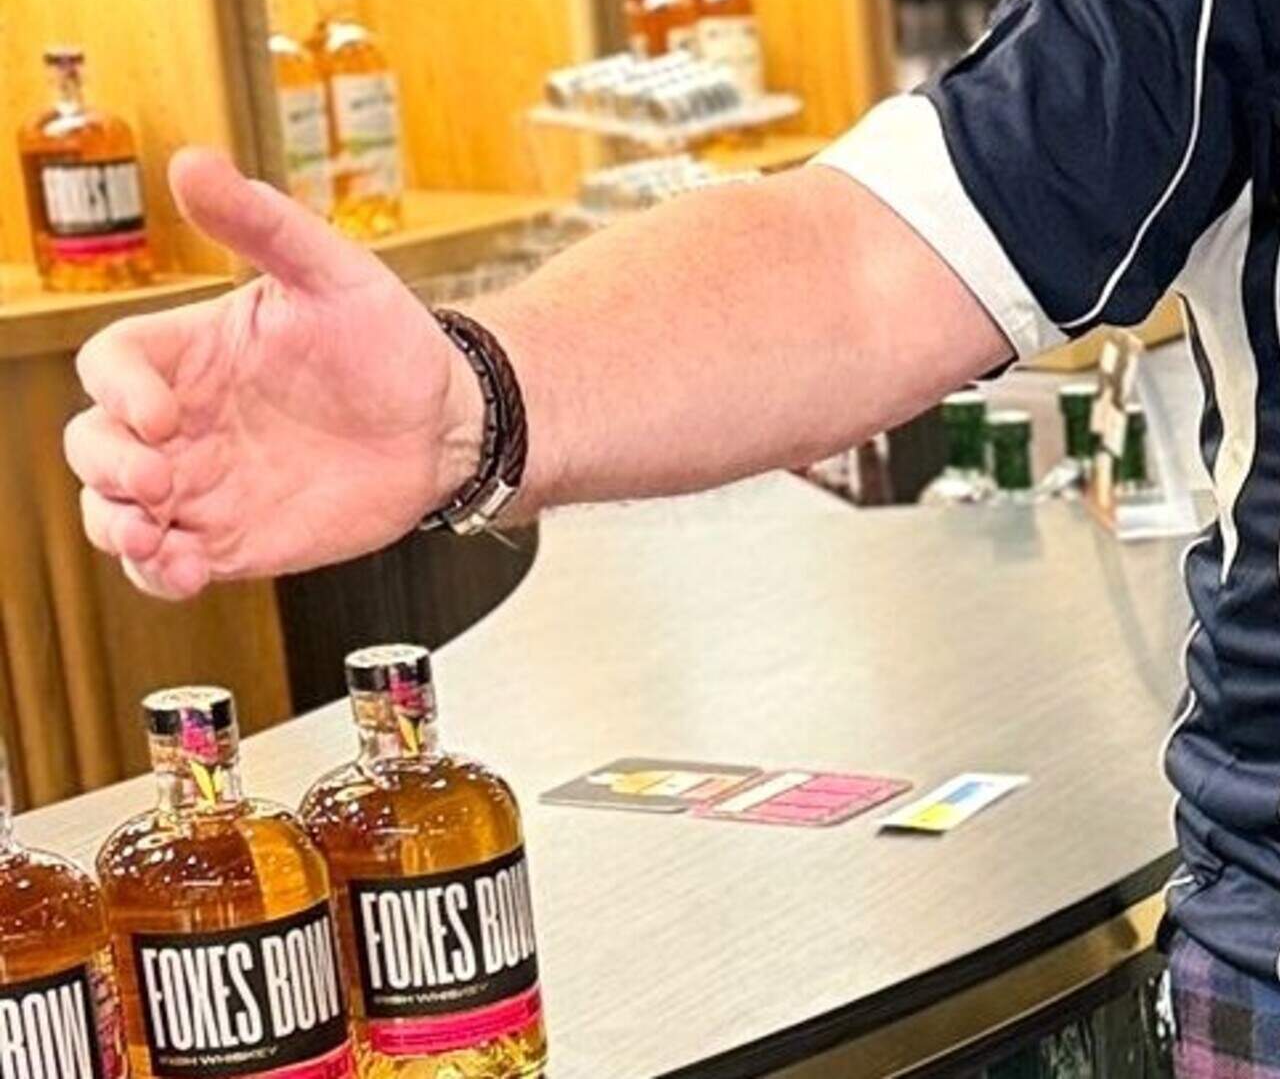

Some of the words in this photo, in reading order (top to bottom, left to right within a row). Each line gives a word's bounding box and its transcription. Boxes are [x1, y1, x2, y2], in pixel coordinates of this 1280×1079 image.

[141, 942, 264, 1051] FOXES
[260, 915, 341, 1038] BOW
[360, 882, 477, 990] FOXES
